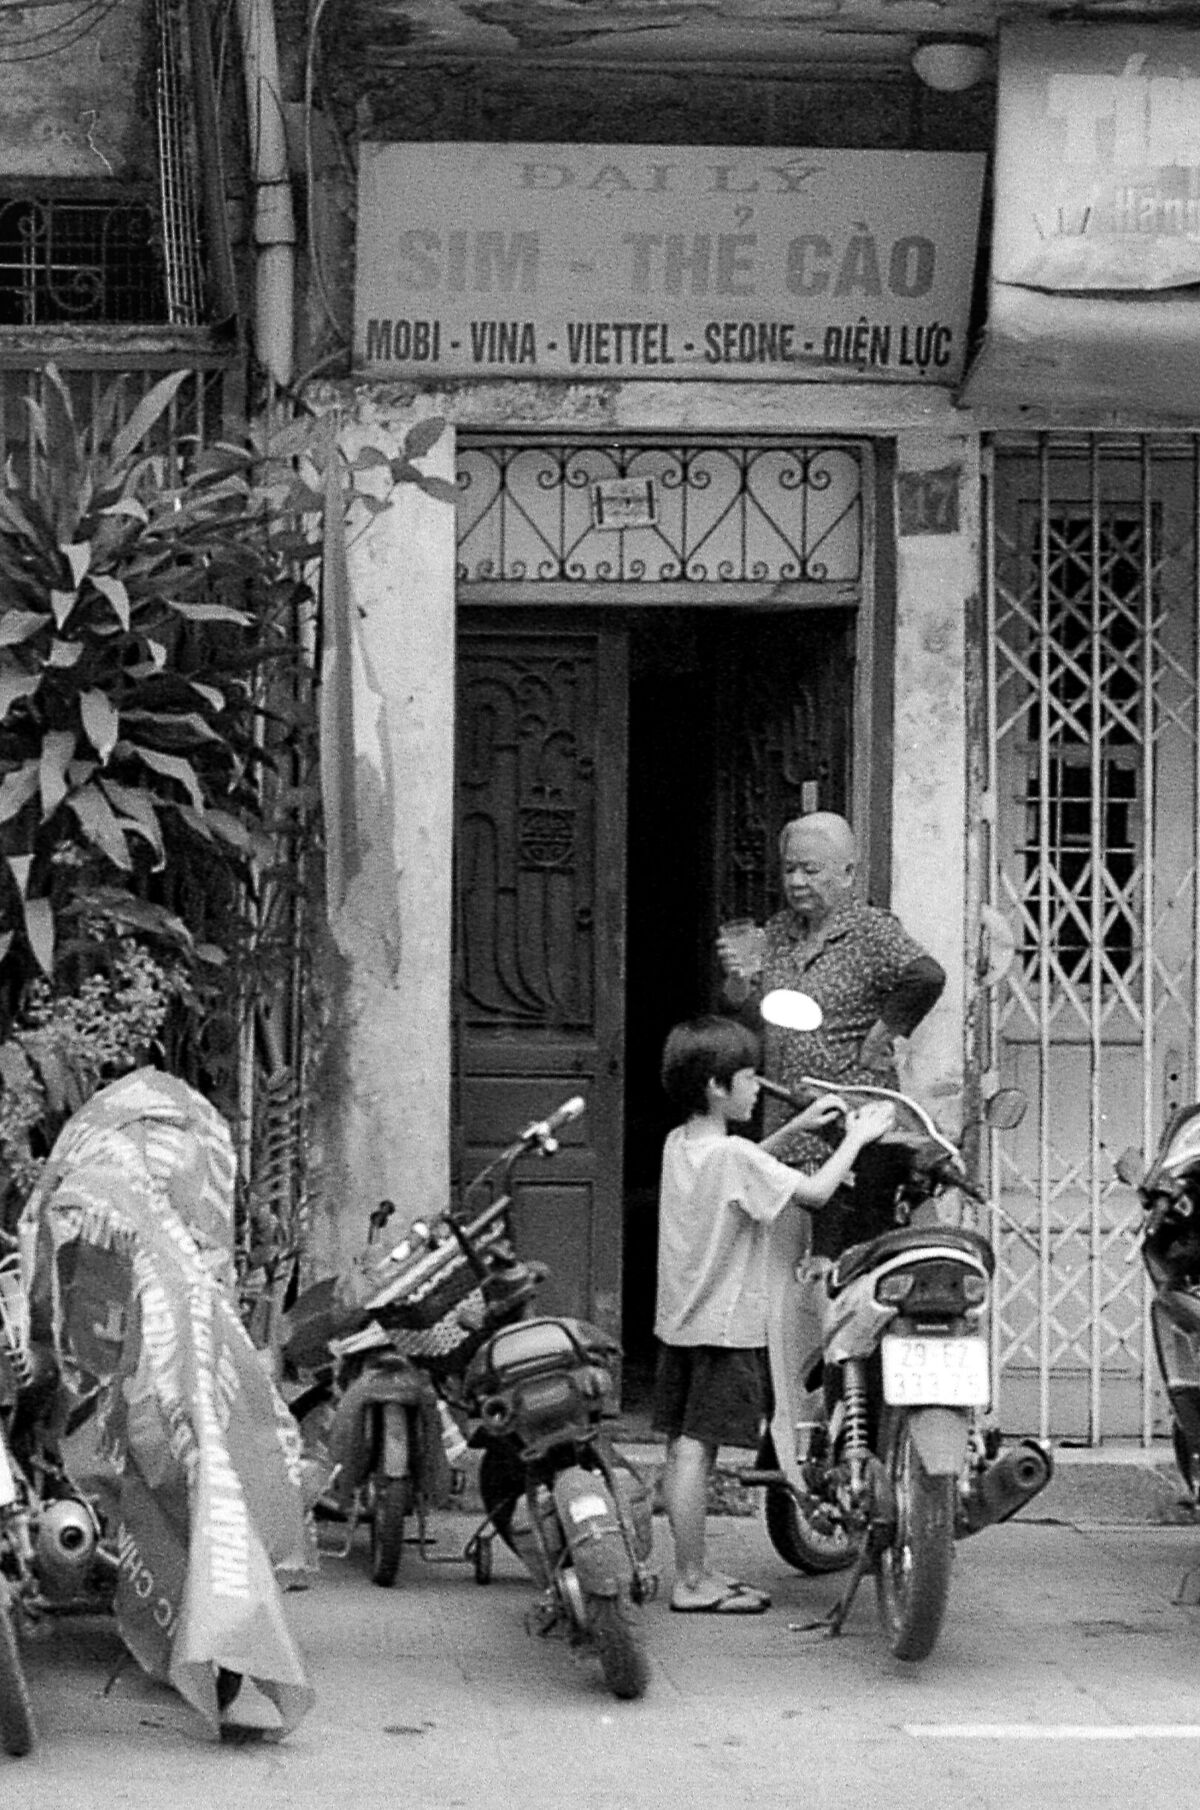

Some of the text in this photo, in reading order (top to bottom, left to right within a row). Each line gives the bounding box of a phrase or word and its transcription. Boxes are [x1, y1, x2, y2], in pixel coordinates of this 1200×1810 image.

[399, 229, 540, 293] SIM
[785, 220, 936, 299] CÀO
[366, 318, 440, 361] MOBI
[470, 321, 536, 364] VINA
[566, 322, 675, 365] VIETTEL
[704, 322, 796, 364] SFONE
